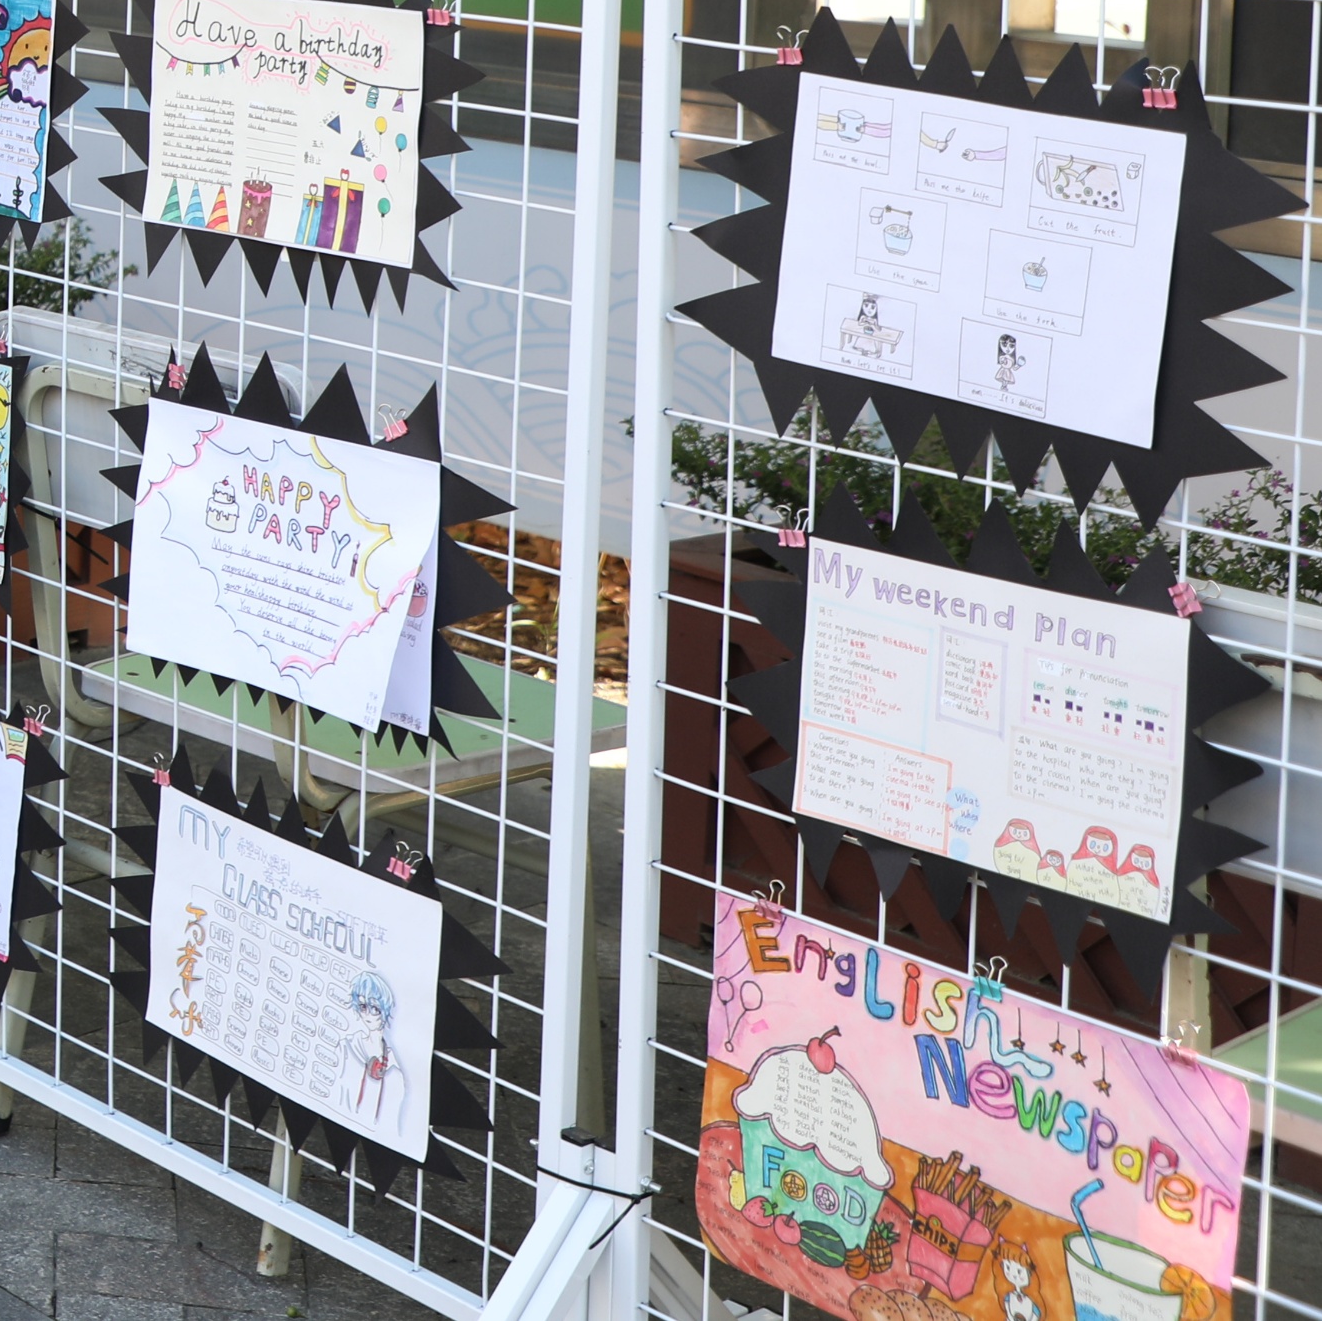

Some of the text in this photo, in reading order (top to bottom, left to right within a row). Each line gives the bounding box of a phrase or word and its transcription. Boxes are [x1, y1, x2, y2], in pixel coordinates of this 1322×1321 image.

[253, 51, 308, 85] party
[274, 31, 293, 53] a
[299, 19, 384, 69] birthday
[1038, 216, 1054, 228] Cut
[243, 464, 341, 529] HAPPY
[212, 536, 233, 558] May
[248, 503, 351, 569] PARTY
[814, 548, 1117, 659] My weekend plan
[1061, 663, 1073, 677] for
[895, 753, 923, 770] Answers
[1013, 759, 1026, 770] are
[1031, 764, 1043, 777] my
[1047, 769, 1071, 783] cousin
[1106, 784, 1119, 794] are
[1126, 790, 1140, 801] you
[1143, 793, 1163, 809] going
[1026, 749, 1167, 801] the hospital are They
[1039, 739, 1170, 785] What are you going
[955, 790, 980, 809] What
[1026, 773, 1165, 821] the going the cinema
[948, 820, 973, 837] where
[221, 863, 283, 921] CLASS
[914, 1034, 1236, 1235] Newspaper
[763, 1145, 867, 1227] FOOD
